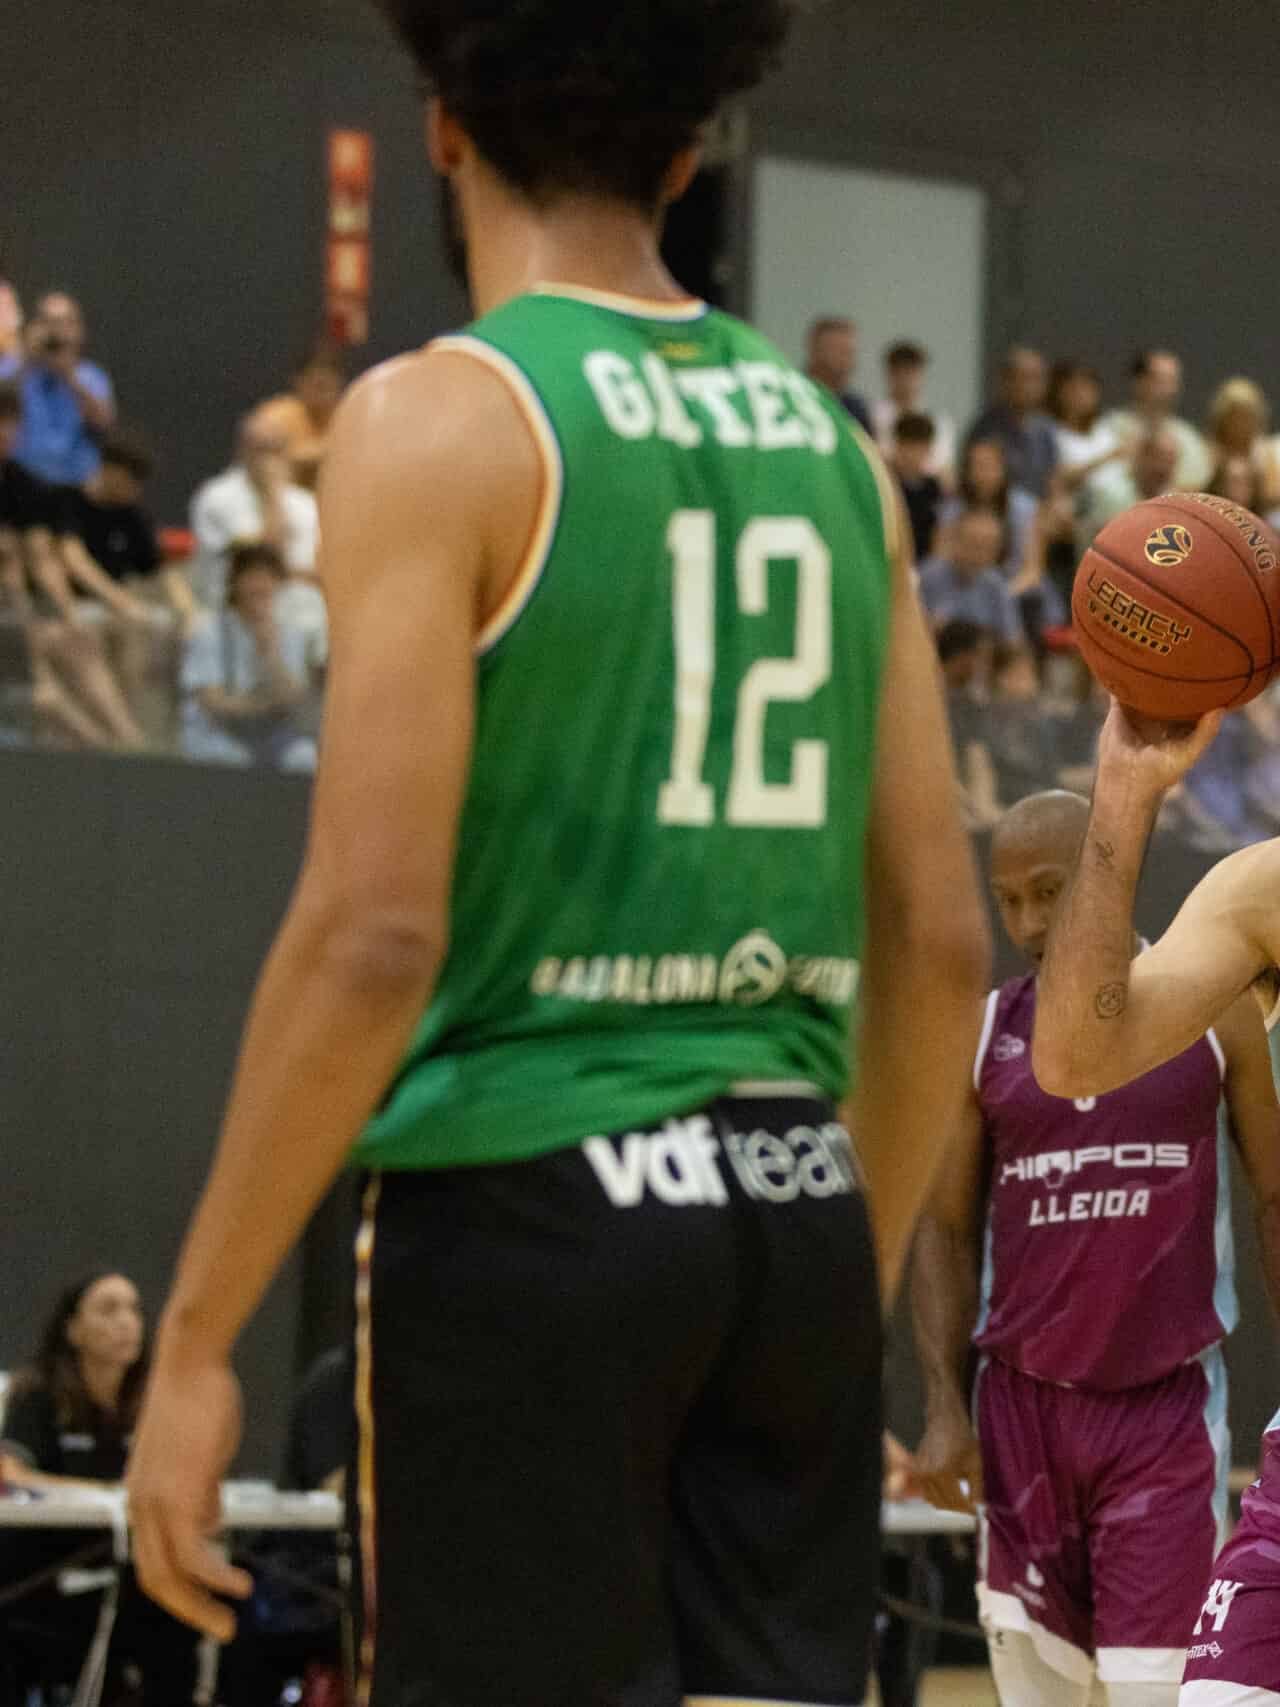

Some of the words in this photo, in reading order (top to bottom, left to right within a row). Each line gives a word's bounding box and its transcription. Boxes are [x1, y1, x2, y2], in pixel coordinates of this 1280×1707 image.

[1087, 568, 1192, 645] LEGACY
[656, 507, 833, 829] 12
[1028, 1189, 1151, 1227] LLEIDA
